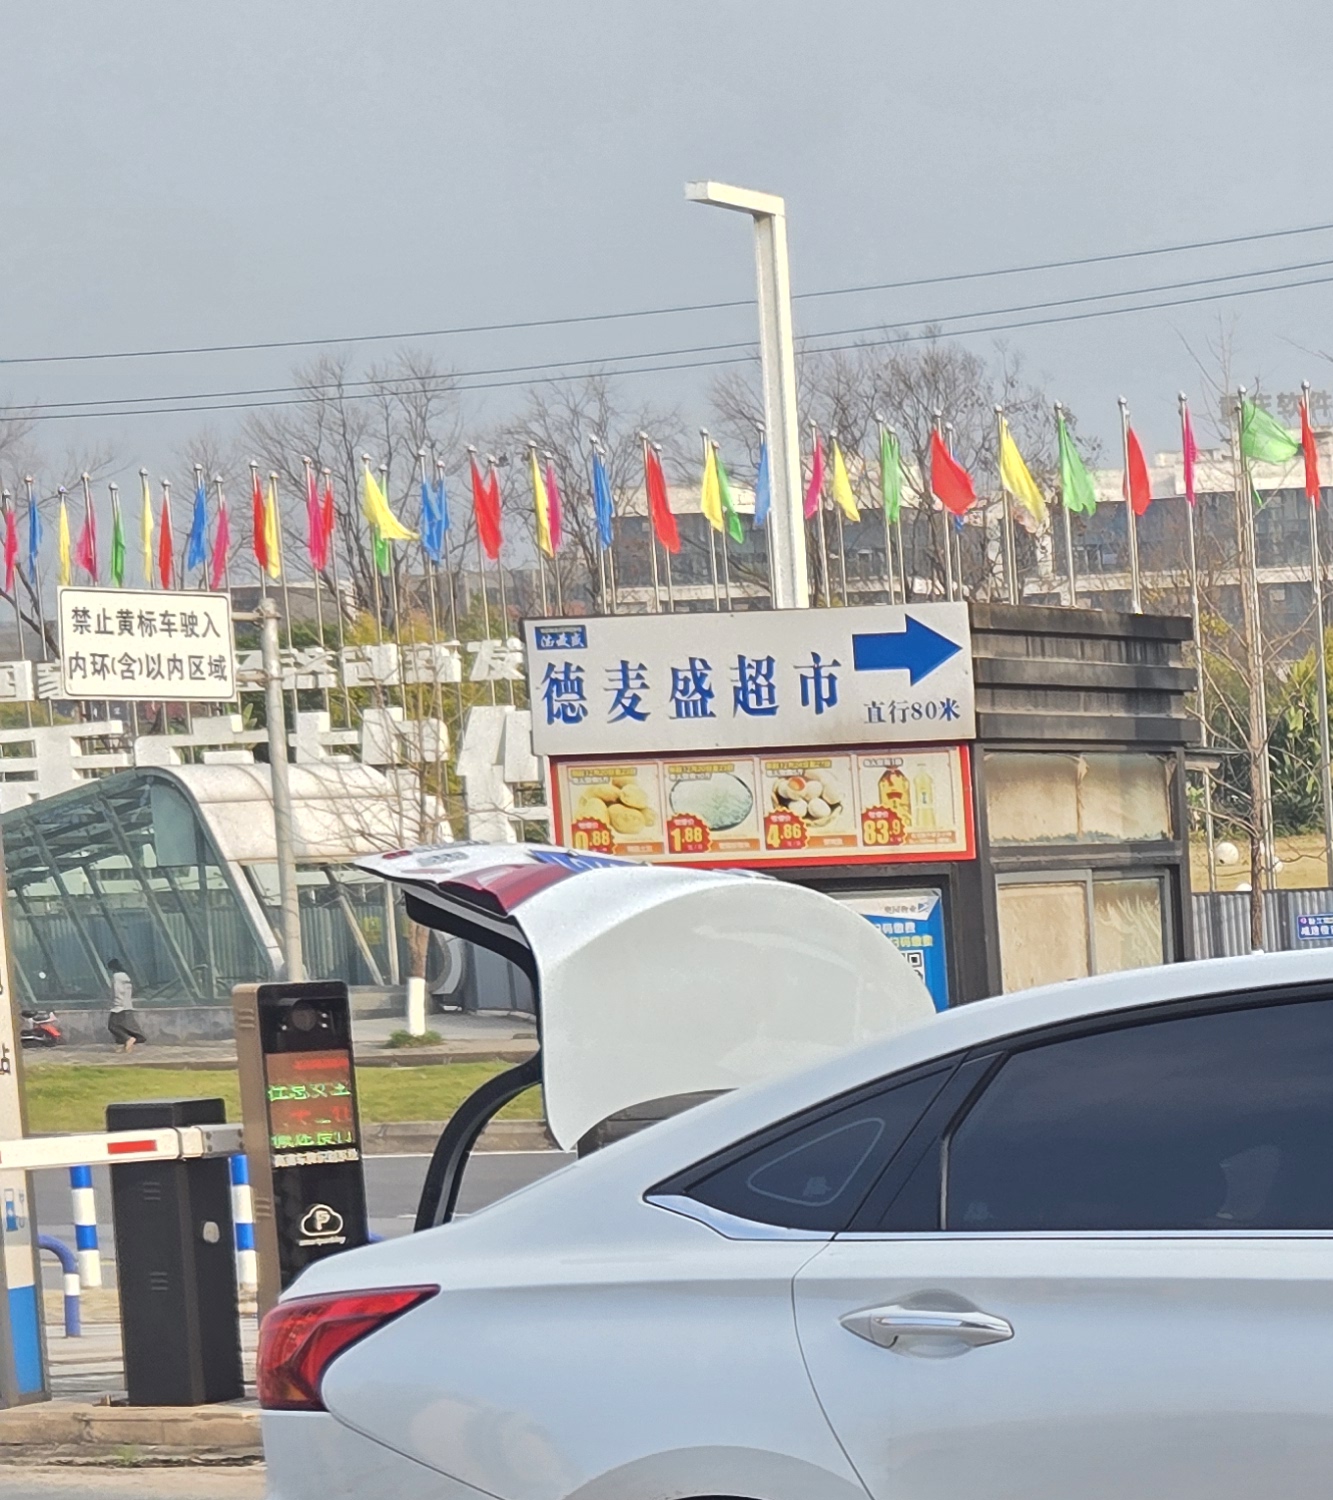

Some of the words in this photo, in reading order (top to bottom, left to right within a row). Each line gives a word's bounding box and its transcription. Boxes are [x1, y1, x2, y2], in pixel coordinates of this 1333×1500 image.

[71, 606, 221, 638] 禁止黄标车驶入
[69, 651, 228, 682] 内环(含)以内区域
[541, 651, 842, 726] 德麦盛超市
[863, 697, 961, 724] 直行80米
[574, 829, 611, 851] 0.88
[671, 826, 703, 852] 1.88
[766, 823, 802, 848] 4.86
[863, 819, 901, 845] 83.9
